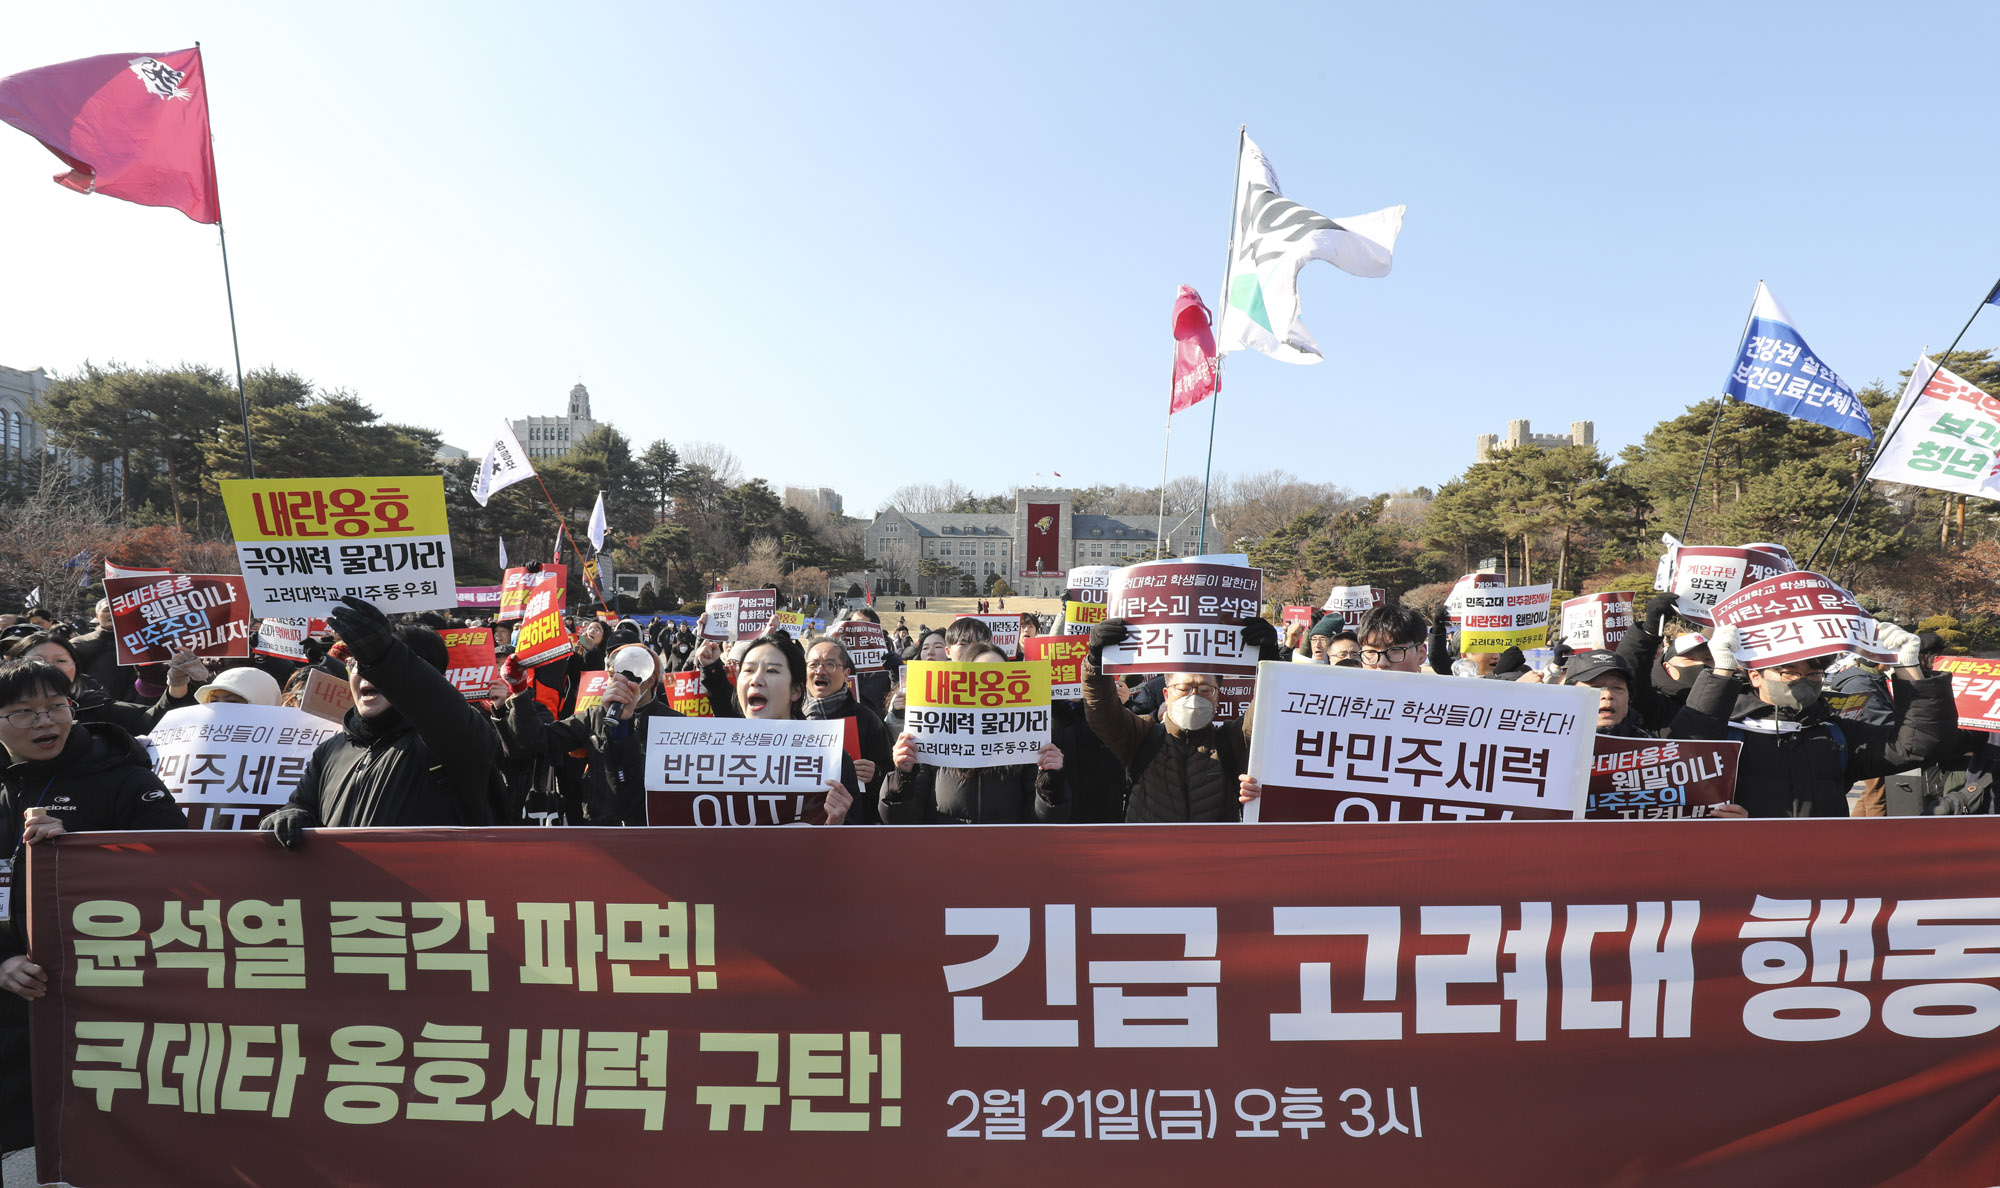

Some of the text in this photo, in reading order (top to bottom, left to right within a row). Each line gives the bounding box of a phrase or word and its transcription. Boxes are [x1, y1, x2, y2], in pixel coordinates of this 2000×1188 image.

[1746, 336, 1802, 367] 건강권
[1907, 440, 1990, 480] 청년
[252, 488, 415, 537] 내란옹호
[243, 541, 446, 576] 극우세력 물러가라
[1073, 576, 1109, 587] 반민주
[1123, 574, 1258, 591] 려대학교 학생들이 말한다!
[1687, 564, 1737, 579] 계엄규탄
[1746, 563, 1784, 580] 계엄
[111, 575, 194, 613] 쿠데타옹호
[263, 581, 438, 603] 고려대학교 민주동우회
[1690, 577, 1728, 592] 압도적
[139, 582, 238, 625] 웬말이냐
[502, 588, 565, 607] 파면!
[739, 598, 774, 608] 계엄규탄
[1109, 595, 1258, 618] 내란수괴 윤석열
[1328, 598, 1372, 609] 민주세력
[1466, 591, 1550, 608] 민족고대 민주광장에서
[1693, 592, 1718, 605] 가결
[1718, 585, 1777, 616] 고려대학교
[1780, 578, 1829, 591] 학생들이
[739, 609, 774, 620] 총회정신
[1465, 615, 1512, 628] 내란집회
[1720, 594, 1813, 627] 내란수괴
[122, 610, 212, 656] 민주주의
[161, 619, 249, 659] 지켜내자
[444, 632, 488, 647] 윤석열
[1118, 628, 1248, 658] 즉각 파면!
[1469, 638, 1513, 647] 고려대학교
[1573, 630, 1589, 639] 가결
[1605, 630, 1627, 643] 이어
[1739, 618, 1880, 651] 즉각 파면!
[1040, 641, 1090, 660] 내란수
[674, 677, 707, 697] 윤석
[925, 670, 1031, 706] 내란옹호
[1220, 686, 1251, 696] 학생들이
[909, 710, 1048, 735] 극우세력 물러가라
[1281, 692, 1576, 736] 고려대학교 학생들이 말한다!
[198, 724, 275, 744] 학생들이
[655, 731, 838, 748] 고려대학교 학생들이 말한다!
[915, 741, 1041, 757] 고려대학교 민주동우회
[152, 753, 312, 795] 민주세
[663, 754, 824, 786] 반민주세력
[1295, 729, 1550, 798] 반민주세력
[1611, 751, 1725, 792] 웬말이냐
[692, 794, 805, 826] OUT!
[72, 900, 718, 993] 윤석열 즉각 파면!
[942, 894, 2000, 1049] 긴급 고려대 행동
[72, 1021, 902, 1132] 쿠데타 옹호세력 규탄!
[945, 1085, 1424, 1142] 2월 21일(금) 오후 3시
